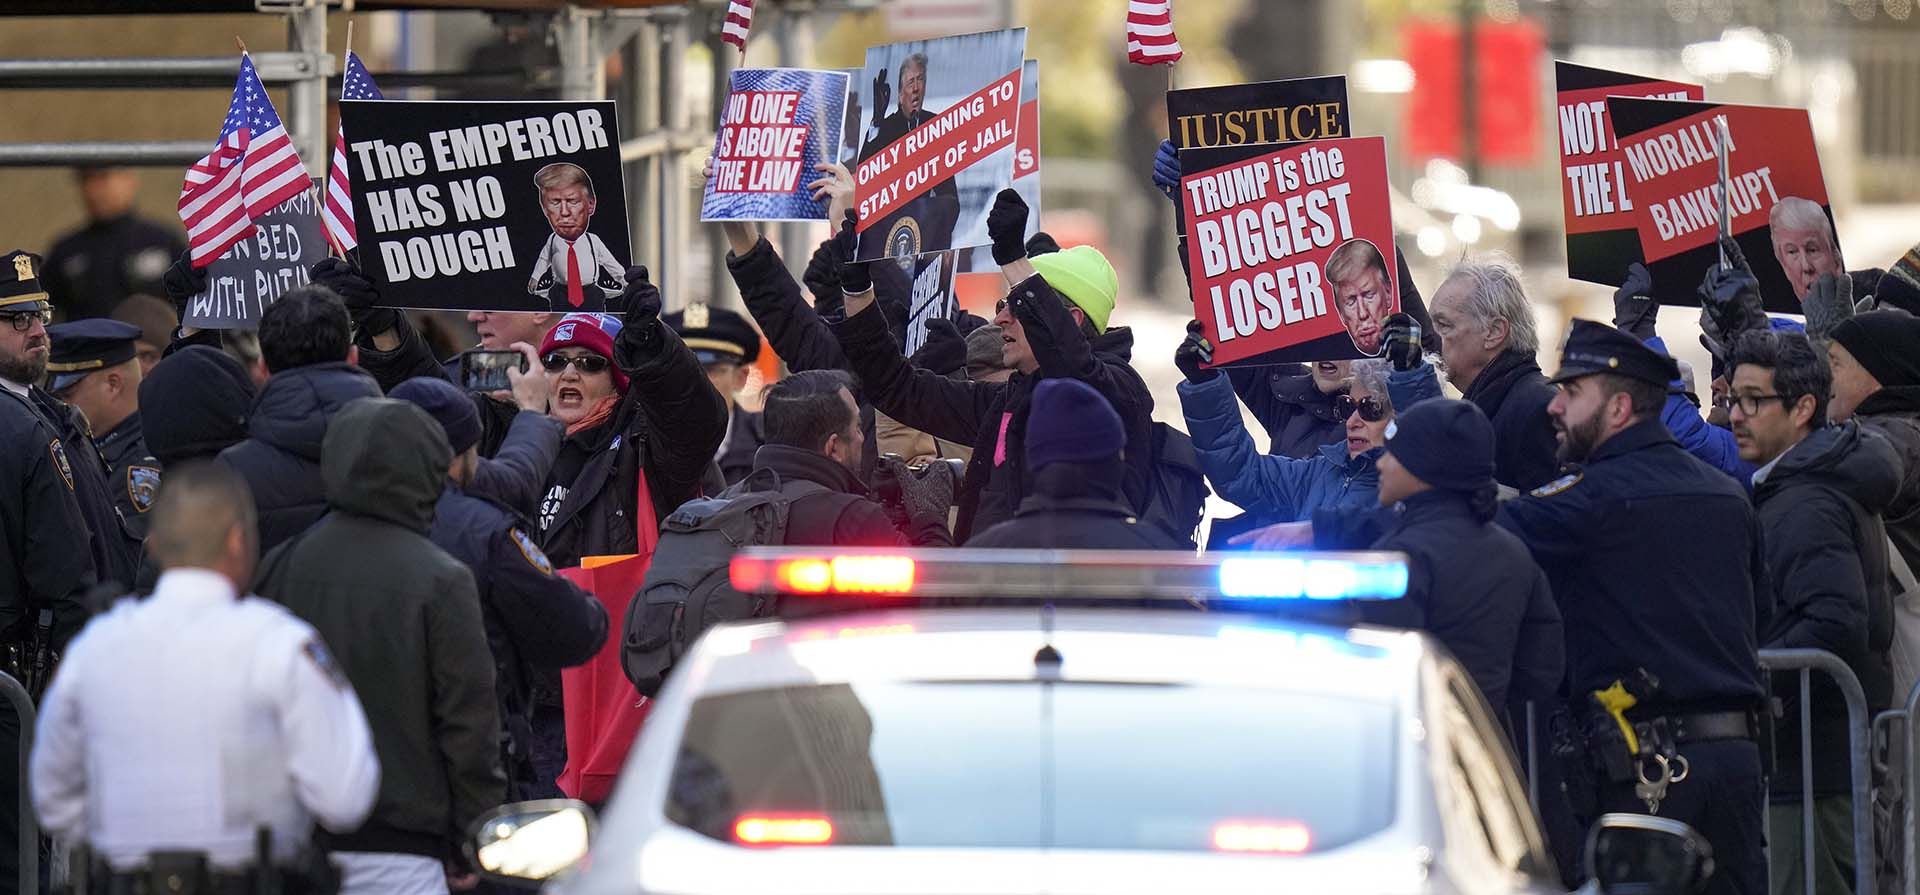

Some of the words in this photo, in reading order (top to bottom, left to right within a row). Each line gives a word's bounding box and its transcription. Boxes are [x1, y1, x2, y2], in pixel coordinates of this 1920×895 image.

[727, 93, 748, 124] NO
[750, 93, 797, 124] ONE
[858, 143, 902, 186] ONLY
[905, 96, 985, 157] RUNNING
[989, 80, 1014, 108] TO
[1177, 102, 1343, 149] JUSTICE
[1559, 101, 1608, 156] NOT
[351, 138, 427, 182] The
[429, 108, 609, 173] EMPEROR
[719, 126, 734, 158] IS
[734, 126, 806, 158] ABOVE
[859, 179, 902, 220] STAY
[905, 156, 940, 192] OUT
[944, 141, 967, 168] OF
[972, 118, 1013, 154] JAIL
[1624, 114, 1737, 184] MORALLY
[365, 183, 447, 234] HAS
[448, 175, 507, 223] NO
[717, 160, 746, 191] THE
[748, 160, 801, 191] LAW
[1186, 161, 1270, 217] TRUMP
[1273, 156, 1300, 194] is
[1301, 146, 1346, 186] the
[1566, 162, 1615, 217] THE
[256, 223, 302, 263] BED
[379, 225, 516, 283] DOUGH
[1196, 182, 1355, 279] BIGGEST
[192, 276, 248, 319] WITH
[1210, 261, 1327, 343] LOSER
